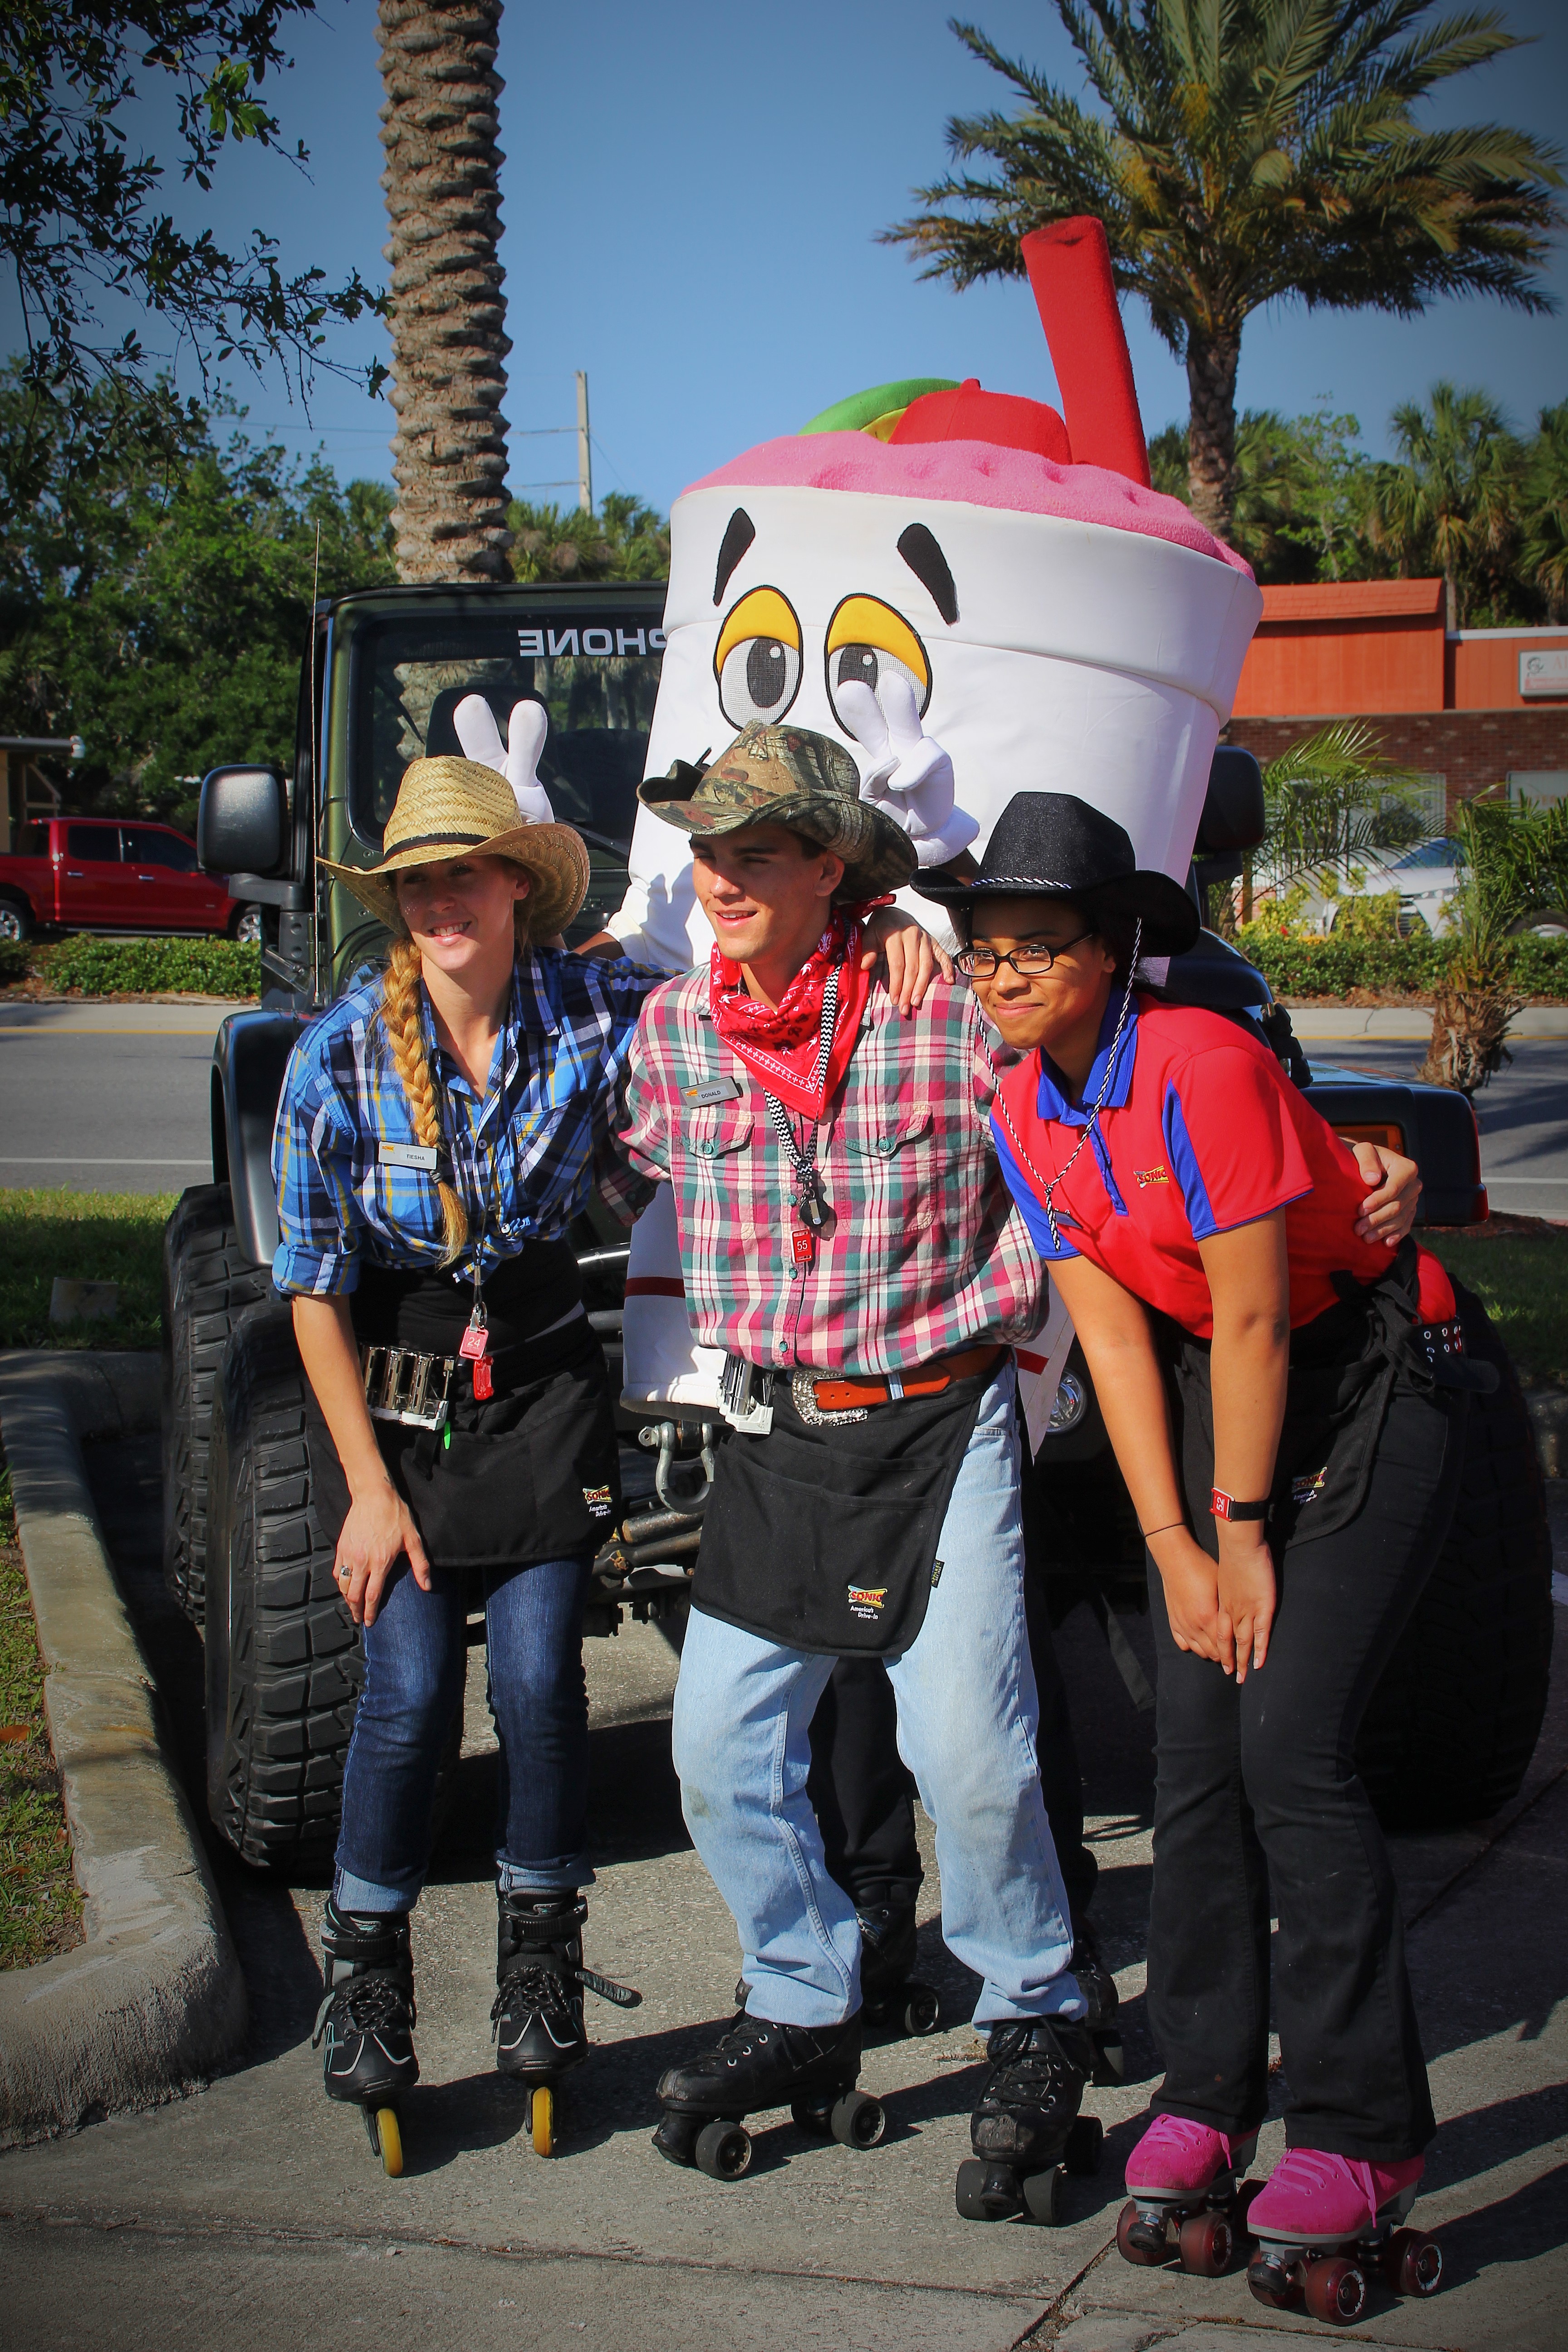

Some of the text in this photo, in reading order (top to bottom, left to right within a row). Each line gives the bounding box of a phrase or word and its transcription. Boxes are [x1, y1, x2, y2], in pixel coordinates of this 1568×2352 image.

[701, 1090, 721, 1098] DONALD
[1138, 1170, 1167, 1183] SONIC
[797, 1240, 808, 1251] 55
[467, 1337, 480, 1348] 24
[1216, 1496, 1225, 1512] 52
[931, 1561, 941, 1584] APPAREL
[851, 1591, 884, 1602] SONIC
[850, 1605, 874, 1613] America's
